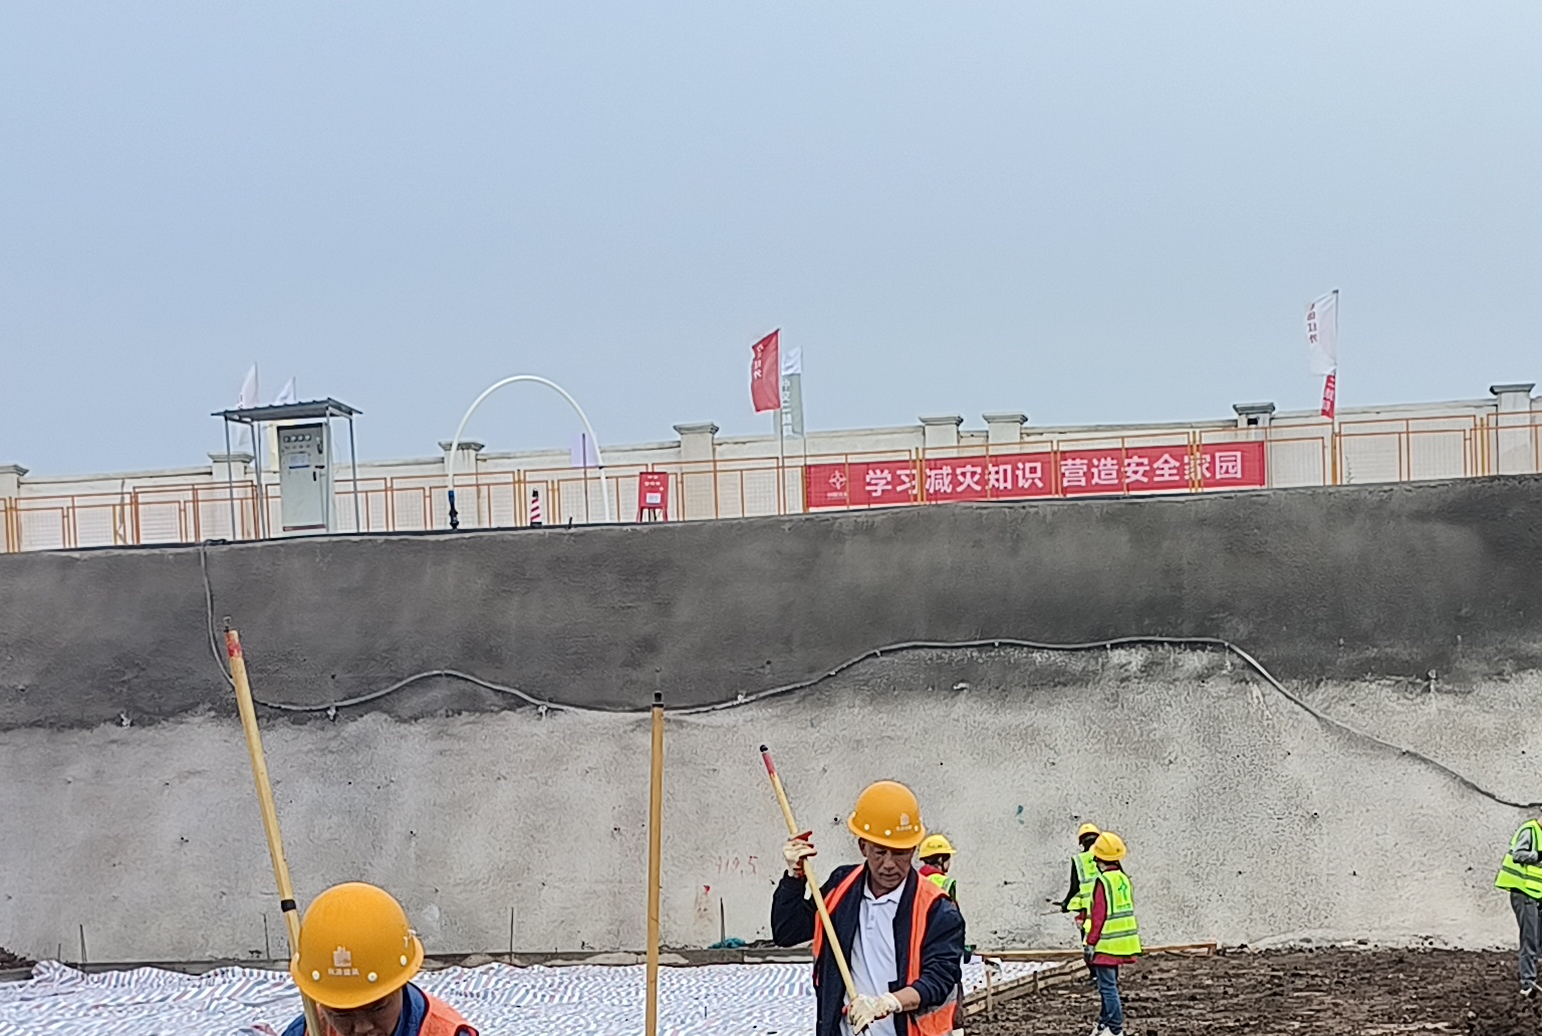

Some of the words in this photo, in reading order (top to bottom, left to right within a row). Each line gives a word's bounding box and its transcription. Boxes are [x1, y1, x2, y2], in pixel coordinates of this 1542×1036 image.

[865, 462, 1044, 497] 学习减灾知识
[1060, 451, 1242, 487] 营造安全家园
